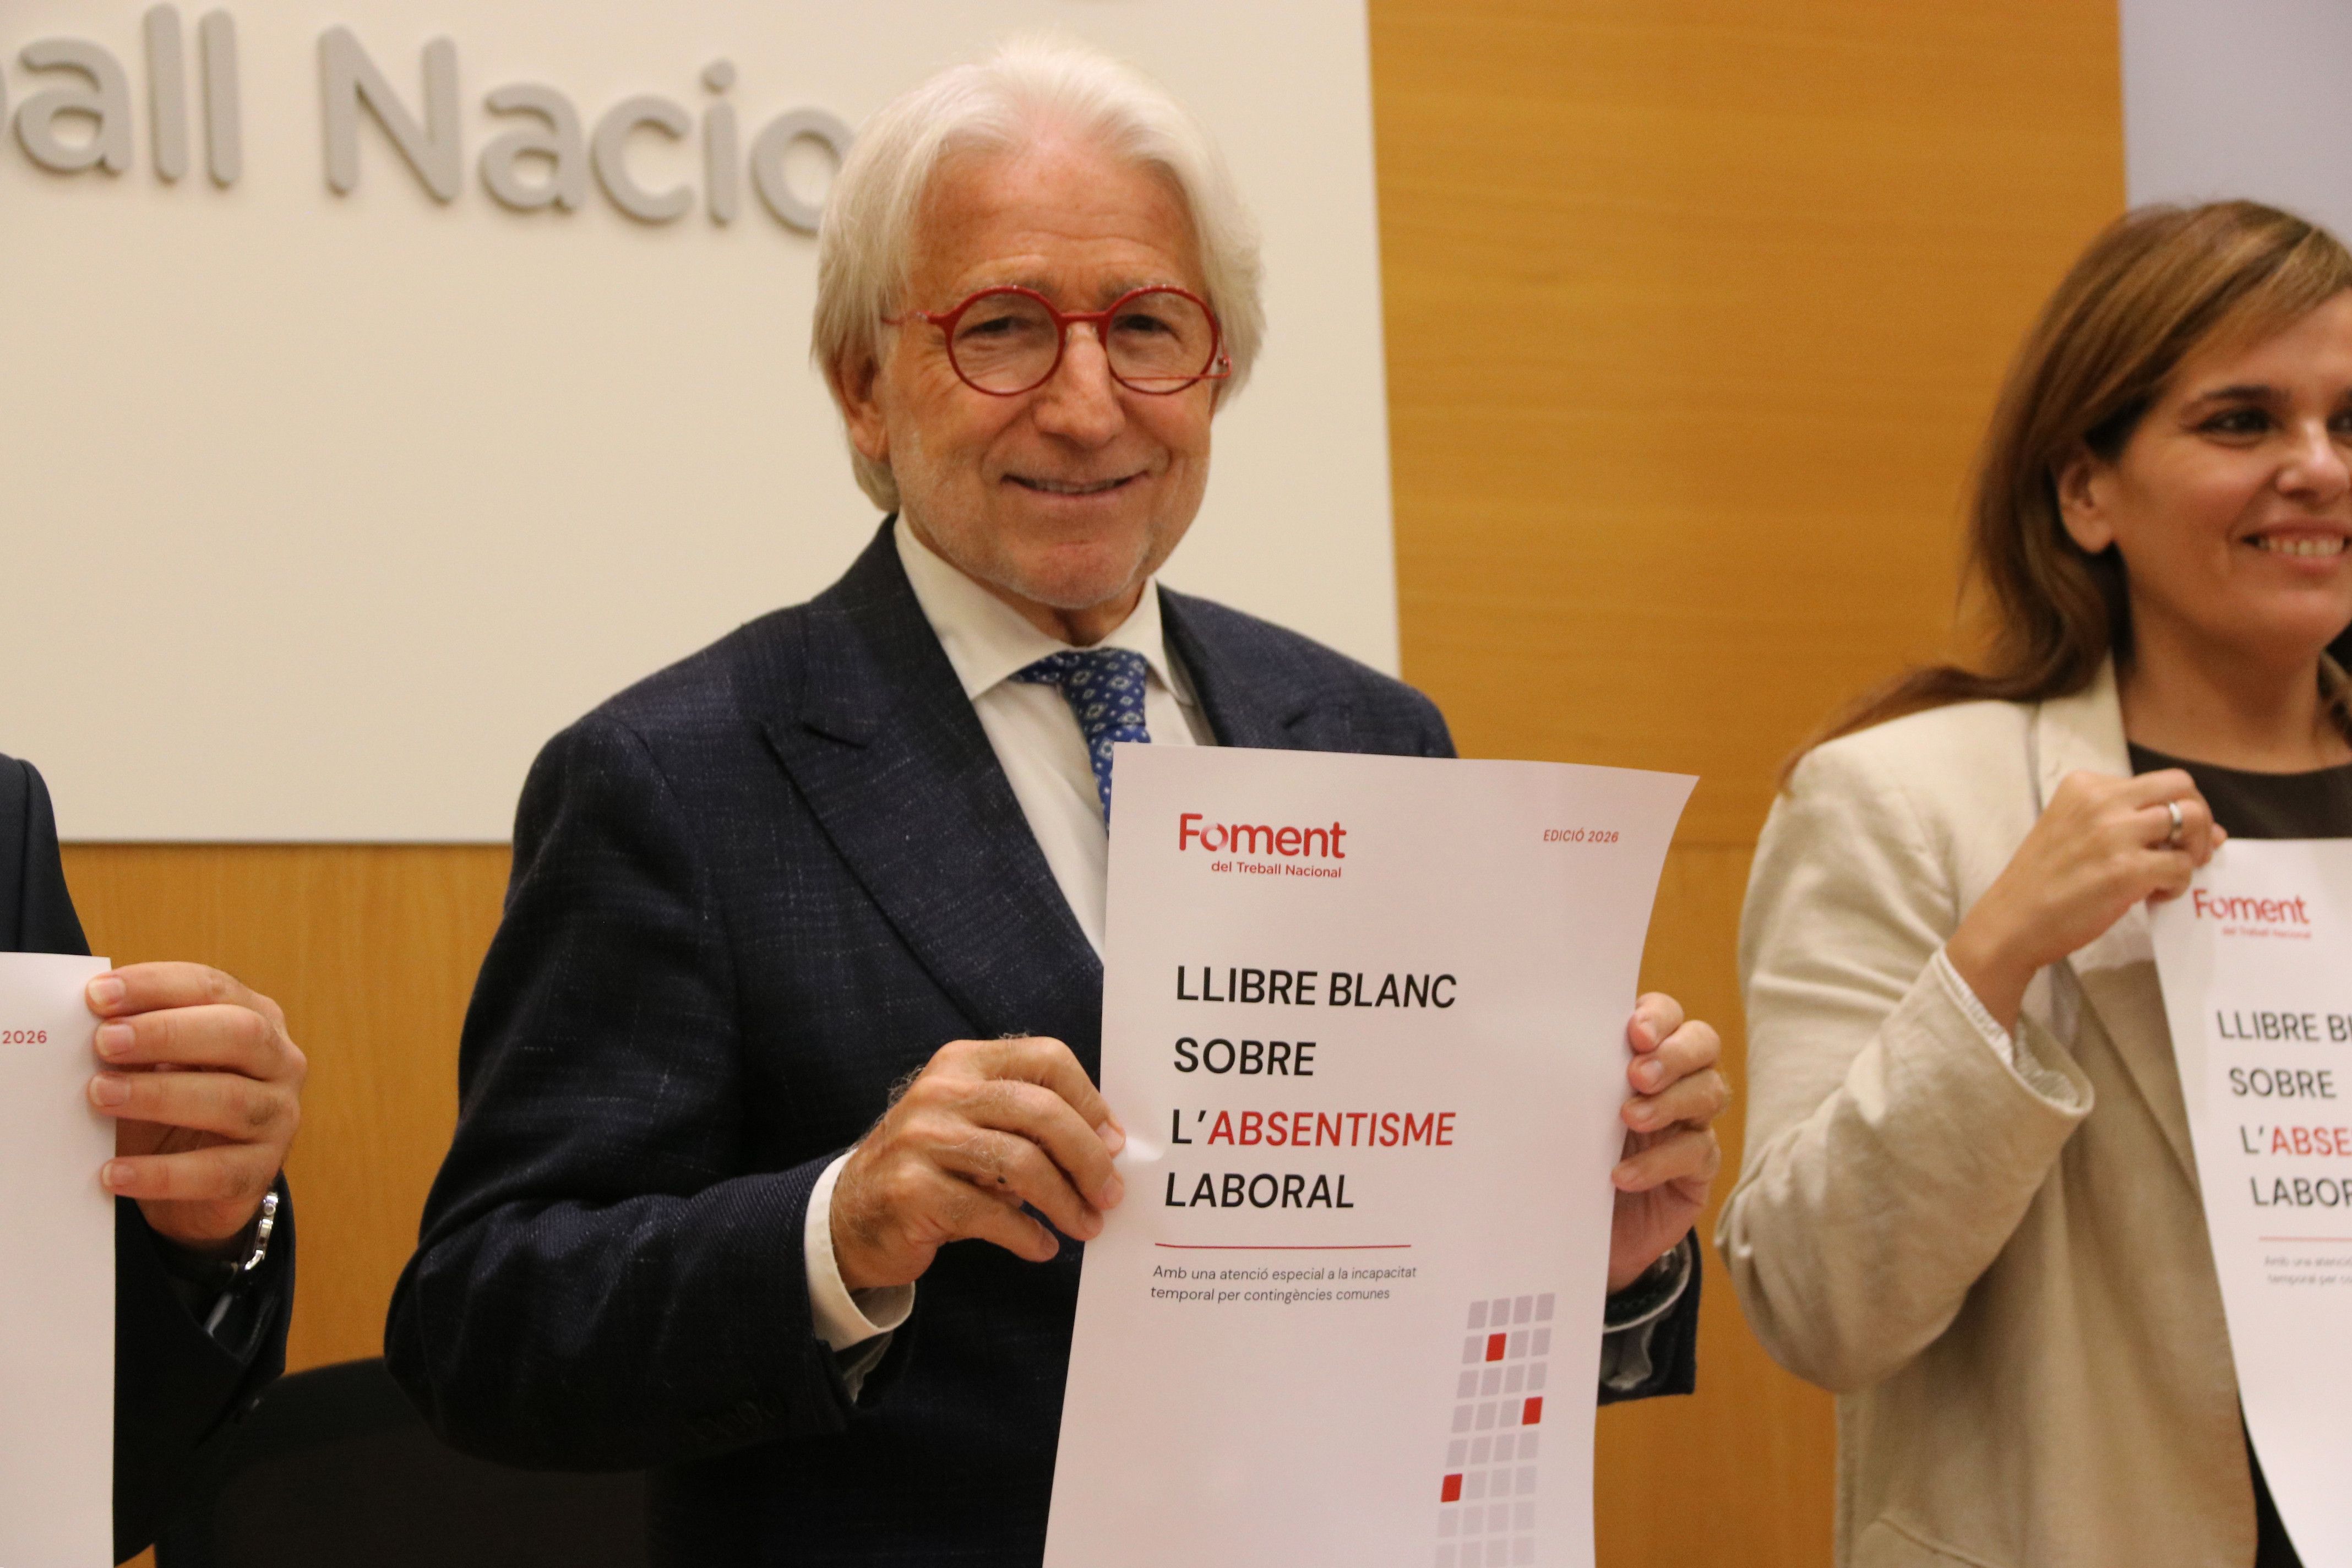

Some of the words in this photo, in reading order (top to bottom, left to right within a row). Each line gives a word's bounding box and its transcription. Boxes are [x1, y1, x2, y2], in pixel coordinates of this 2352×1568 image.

[0, 1, 241, 190] all
[1179, 813, 1347, 858] Foment
[1543, 827, 1585, 842] EDICIÓ
[1588, 830, 1619, 843] 2026
[1211, 861, 1232, 872] del
[1237, 862, 1281, 875] Treball
[1286, 864, 1341, 878] Nacional
[2193, 889, 2310, 924] Foment
[1177, 965, 1317, 1005] LLIBRE
[1328, 972, 1457, 1009] BLANC
[2, 1030, 47, 1044] 2026
[2217, 1010, 2321, 1041] LLIBRE
[1173, 1037, 1316, 1076] SOBRE
[2229, 1068, 2337, 1098] SOBRE
[1164, 1172, 1354, 1209] LABORAL
[1153, 1265, 1187, 1278] Amb
[1191, 1270, 1216, 1280] una
[1220, 1267, 1268, 1280] atenció
[1272, 1268, 1325, 1283] especial
[1327, 1270, 1335, 1280] a
[1338, 1267, 1348, 1280] la
[1352, 1266, 1417, 1282] incapacitat
[1151, 1286, 1215, 1303] temporal
[1217, 1291, 1240, 1304] per
[1244, 1288, 1332, 1304] contingències
[1336, 1289, 1390, 1300] comunes
